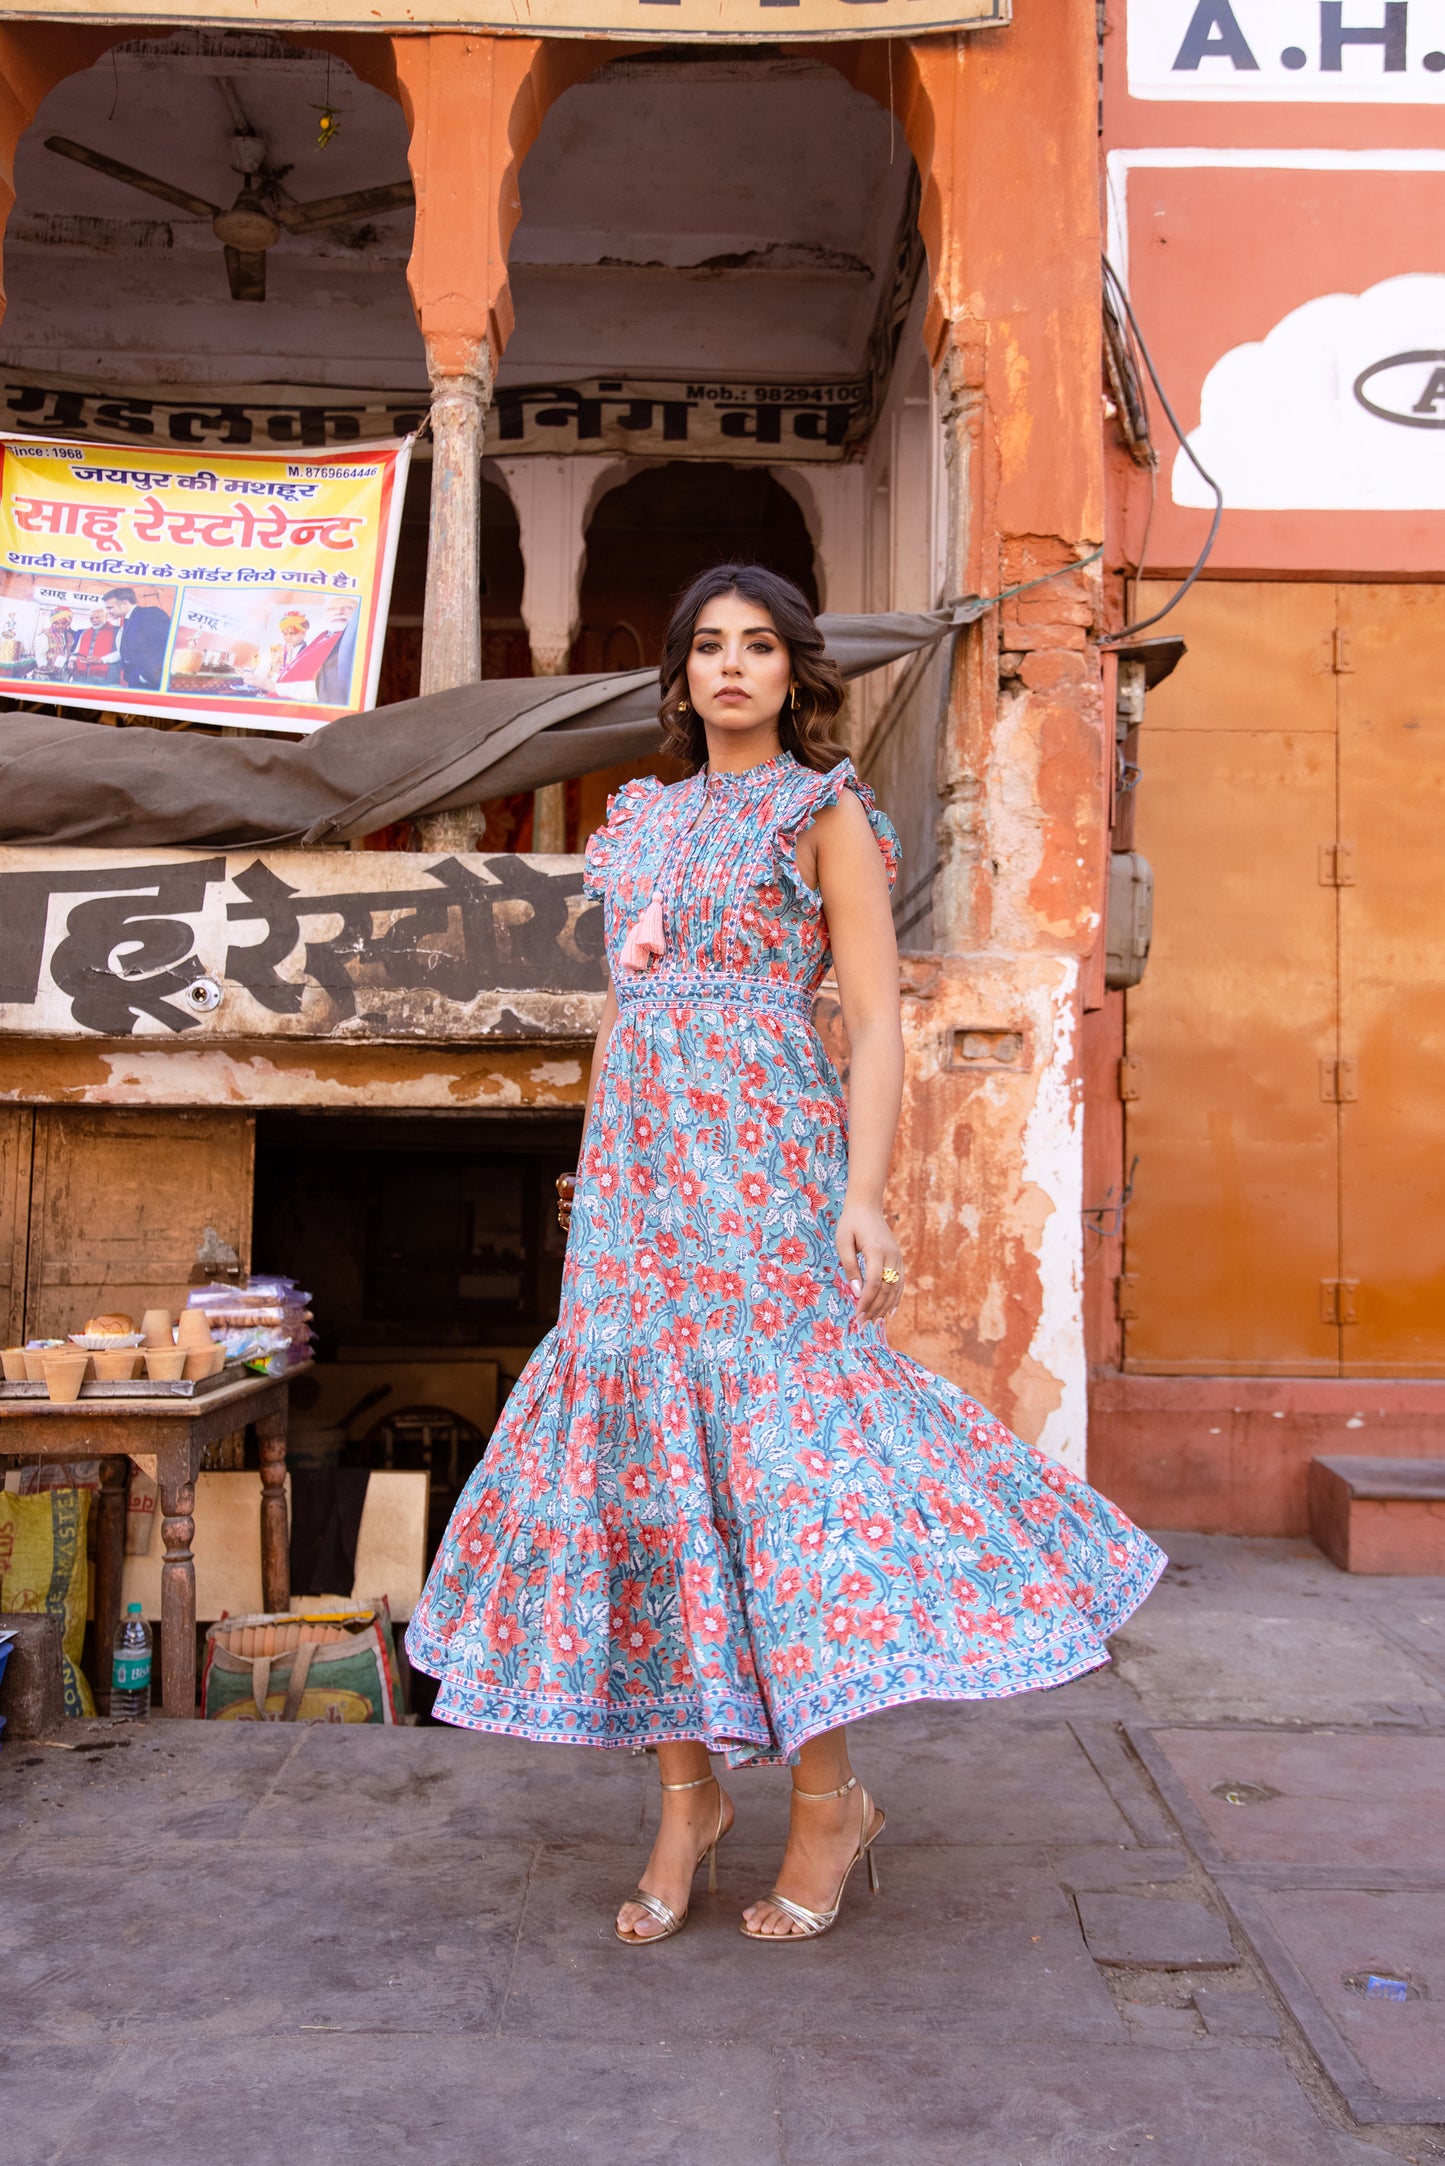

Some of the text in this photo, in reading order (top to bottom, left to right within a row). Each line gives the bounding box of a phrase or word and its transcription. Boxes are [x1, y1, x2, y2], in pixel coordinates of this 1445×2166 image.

[71, 465, 319, 501] जयपुर की मशहूर
[14, 495, 363, 552] साहू रेस्टोरेन्ट
[8, 551, 57, 568] शादी
[60, 559, 77, 570] व
[80, 558, 150, 576] पार्टियों
[152, 563, 176, 578] के
[177, 567, 234, 582] ऑर्डर
[237, 567, 276, 582] लिये
[281, 569, 328, 585] जाते
[39, 588, 100, 603] साहू चाय
[187, 610, 220, 631] साहू
